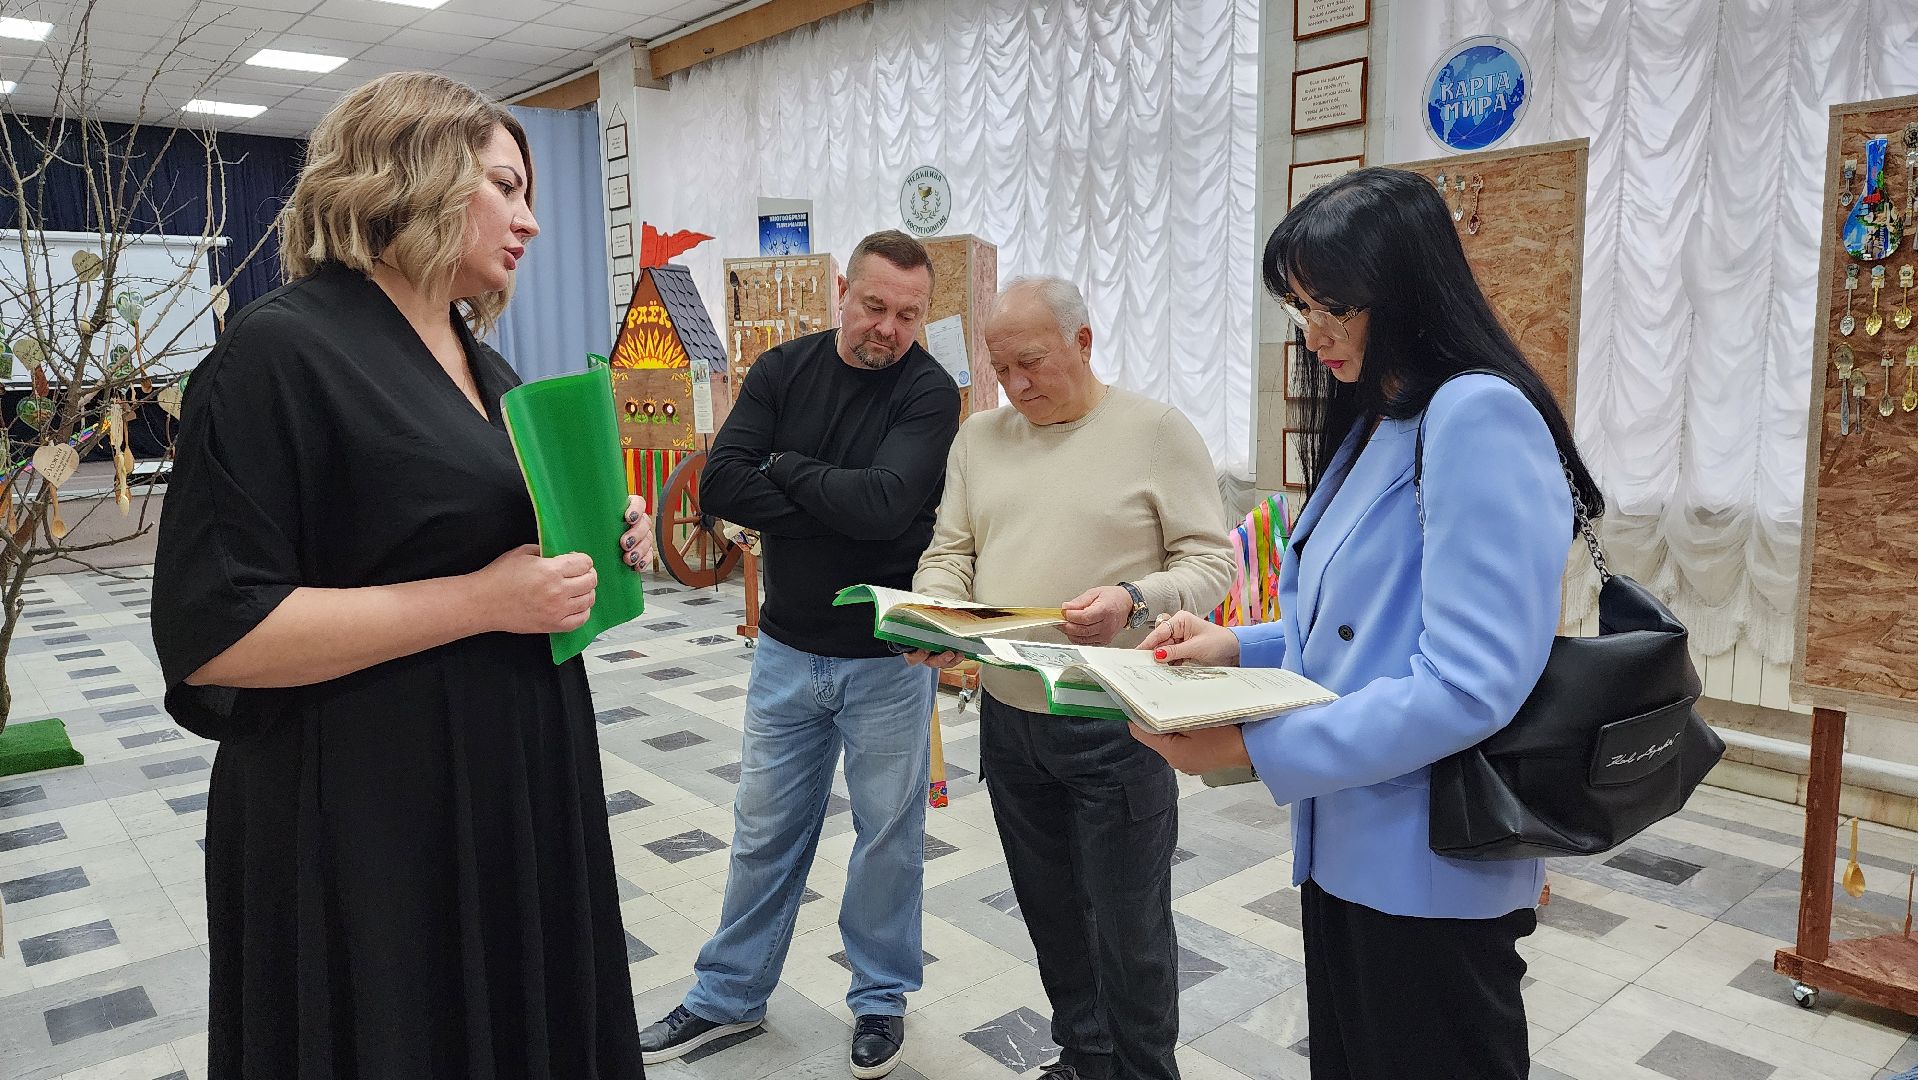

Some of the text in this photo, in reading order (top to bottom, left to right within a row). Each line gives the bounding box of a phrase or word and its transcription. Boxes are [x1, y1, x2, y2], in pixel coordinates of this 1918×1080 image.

[1440, 71, 1510, 102] КАРТА
[1444, 92, 1507, 121] МИРА
[907, 170, 942, 186] МЕДИЦИНА
[906, 215, 947, 234] КОСМЕТОЛОГИЯ
[627, 300, 672, 329] РАЁК
